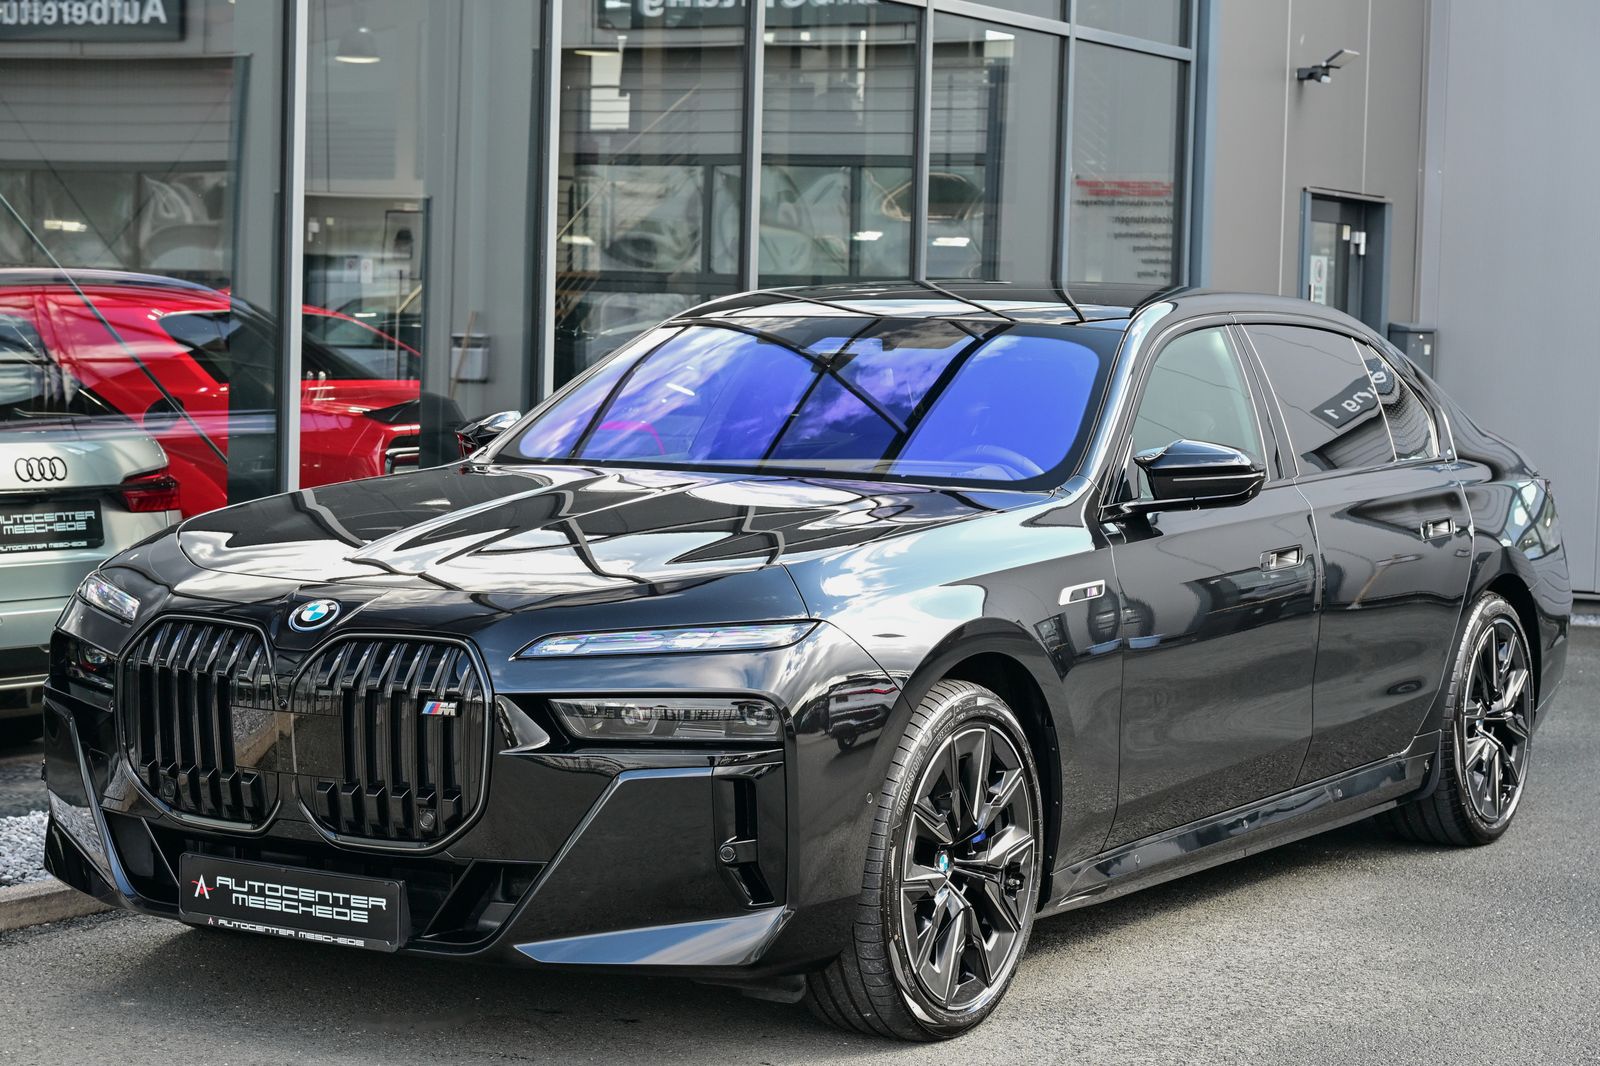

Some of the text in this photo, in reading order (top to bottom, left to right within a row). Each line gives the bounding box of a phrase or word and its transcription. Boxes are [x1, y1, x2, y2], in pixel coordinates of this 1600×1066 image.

[3, 521, 87, 535] MESCHEDE
[896, 751, 925, 816] BRIDGESTONE
[216, 876, 386, 910] AUTOCENTER
[232, 893, 369, 923] MESCHEDE
[218, 919, 295, 937] AUTOCENTER
[298, 931, 365, 947] MESCHEDE
